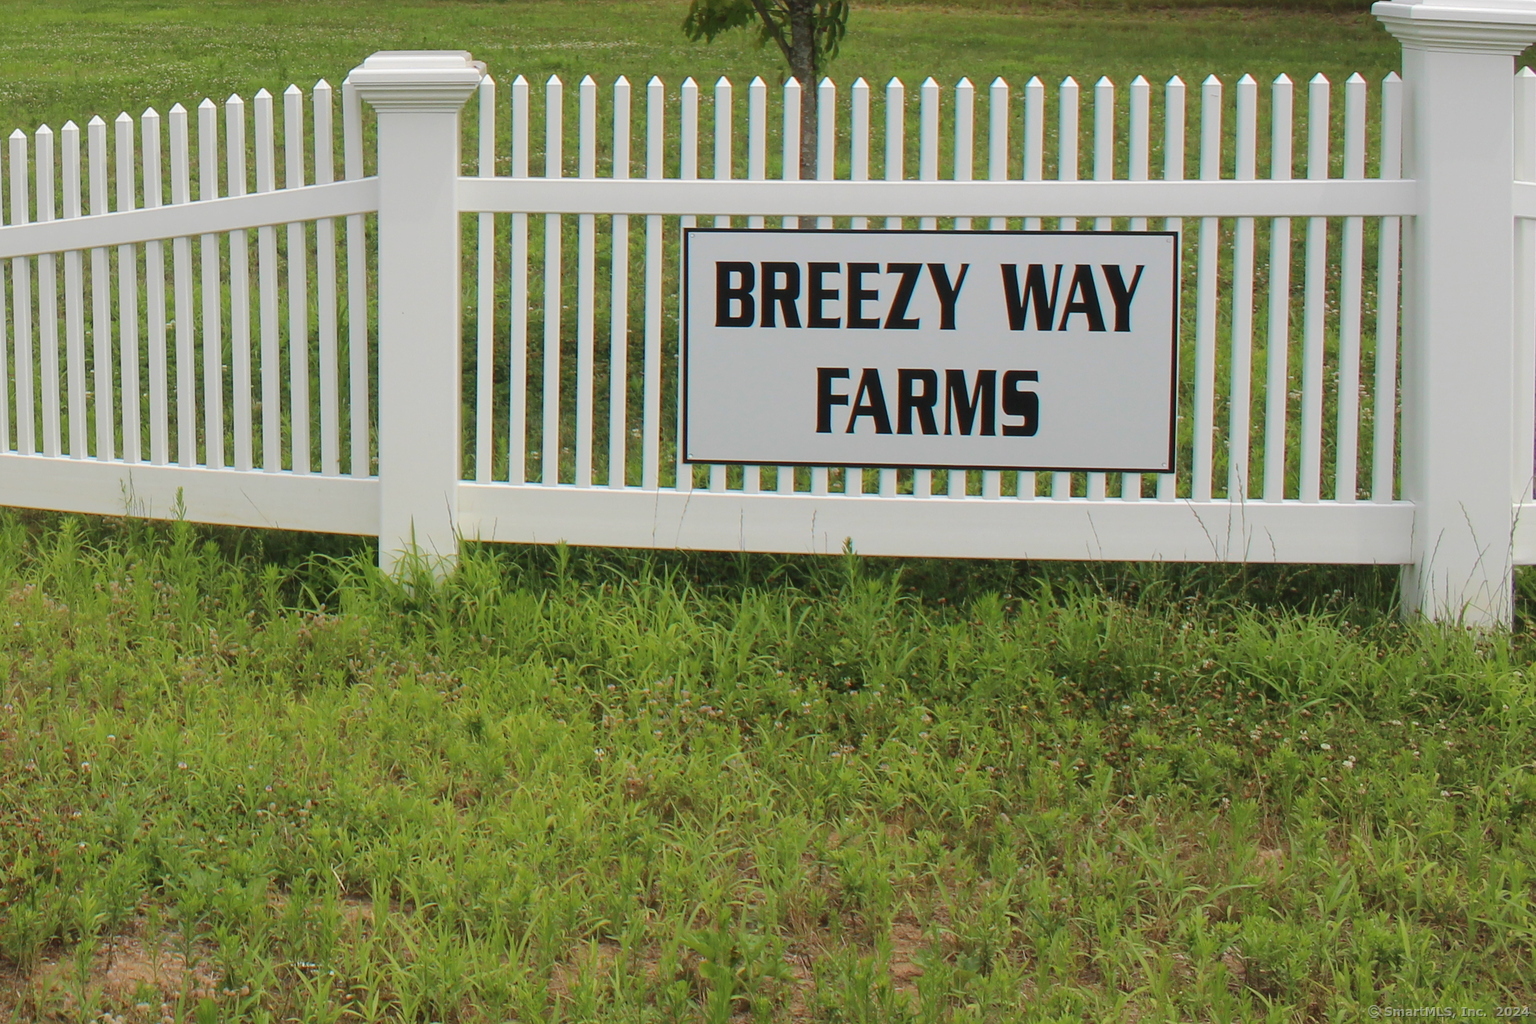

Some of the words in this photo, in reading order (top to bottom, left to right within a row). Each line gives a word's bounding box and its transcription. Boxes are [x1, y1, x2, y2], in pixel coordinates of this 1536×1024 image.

[714, 261, 970, 331] BREEZY
[1000, 263, 1145, 333] WAY
[815, 367, 1040, 437] FARMS
